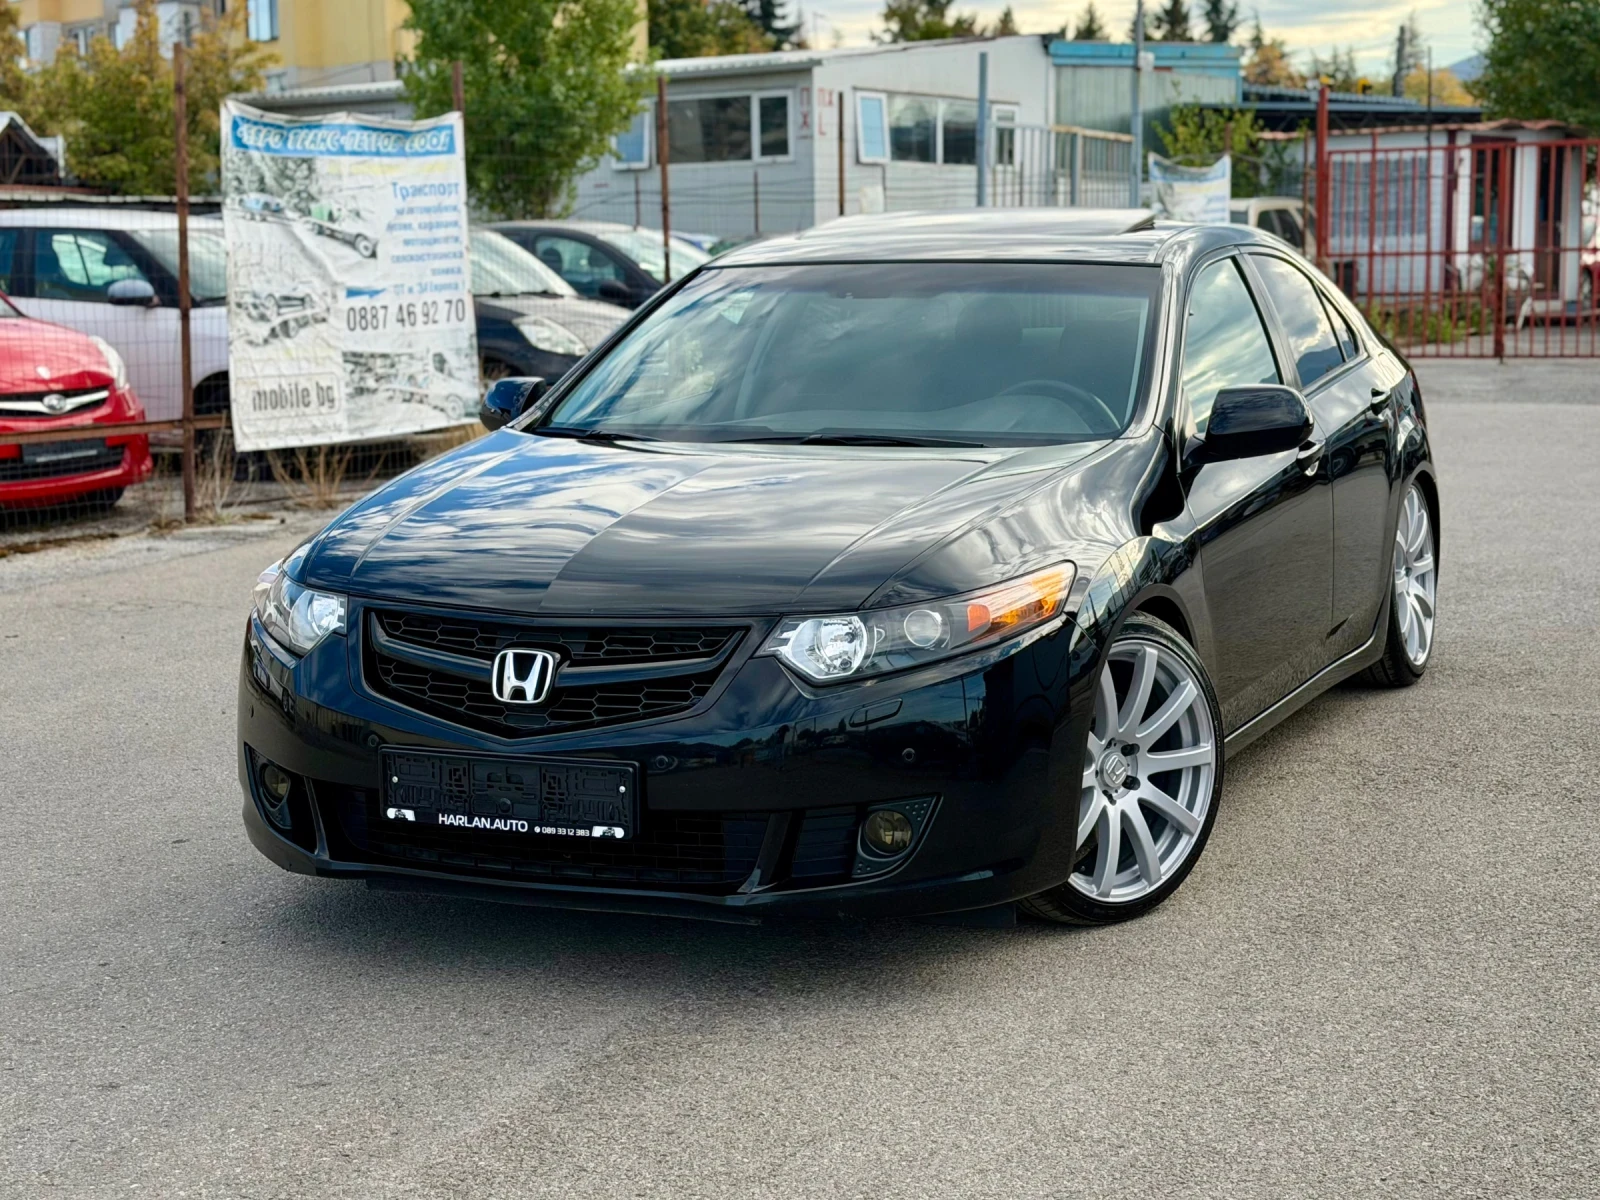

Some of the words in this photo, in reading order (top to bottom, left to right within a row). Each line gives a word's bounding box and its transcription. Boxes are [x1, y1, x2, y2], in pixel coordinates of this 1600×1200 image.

[391, 181, 459, 202] Транспорт
[347, 305, 389, 333] 0887
[396, 303, 417, 328] 46
[422, 300, 438, 326] 92
[445, 298, 466, 323] 70
[438, 813, 529, 833] HARLAN.AUTO
[567, 828, 574, 836] 12
